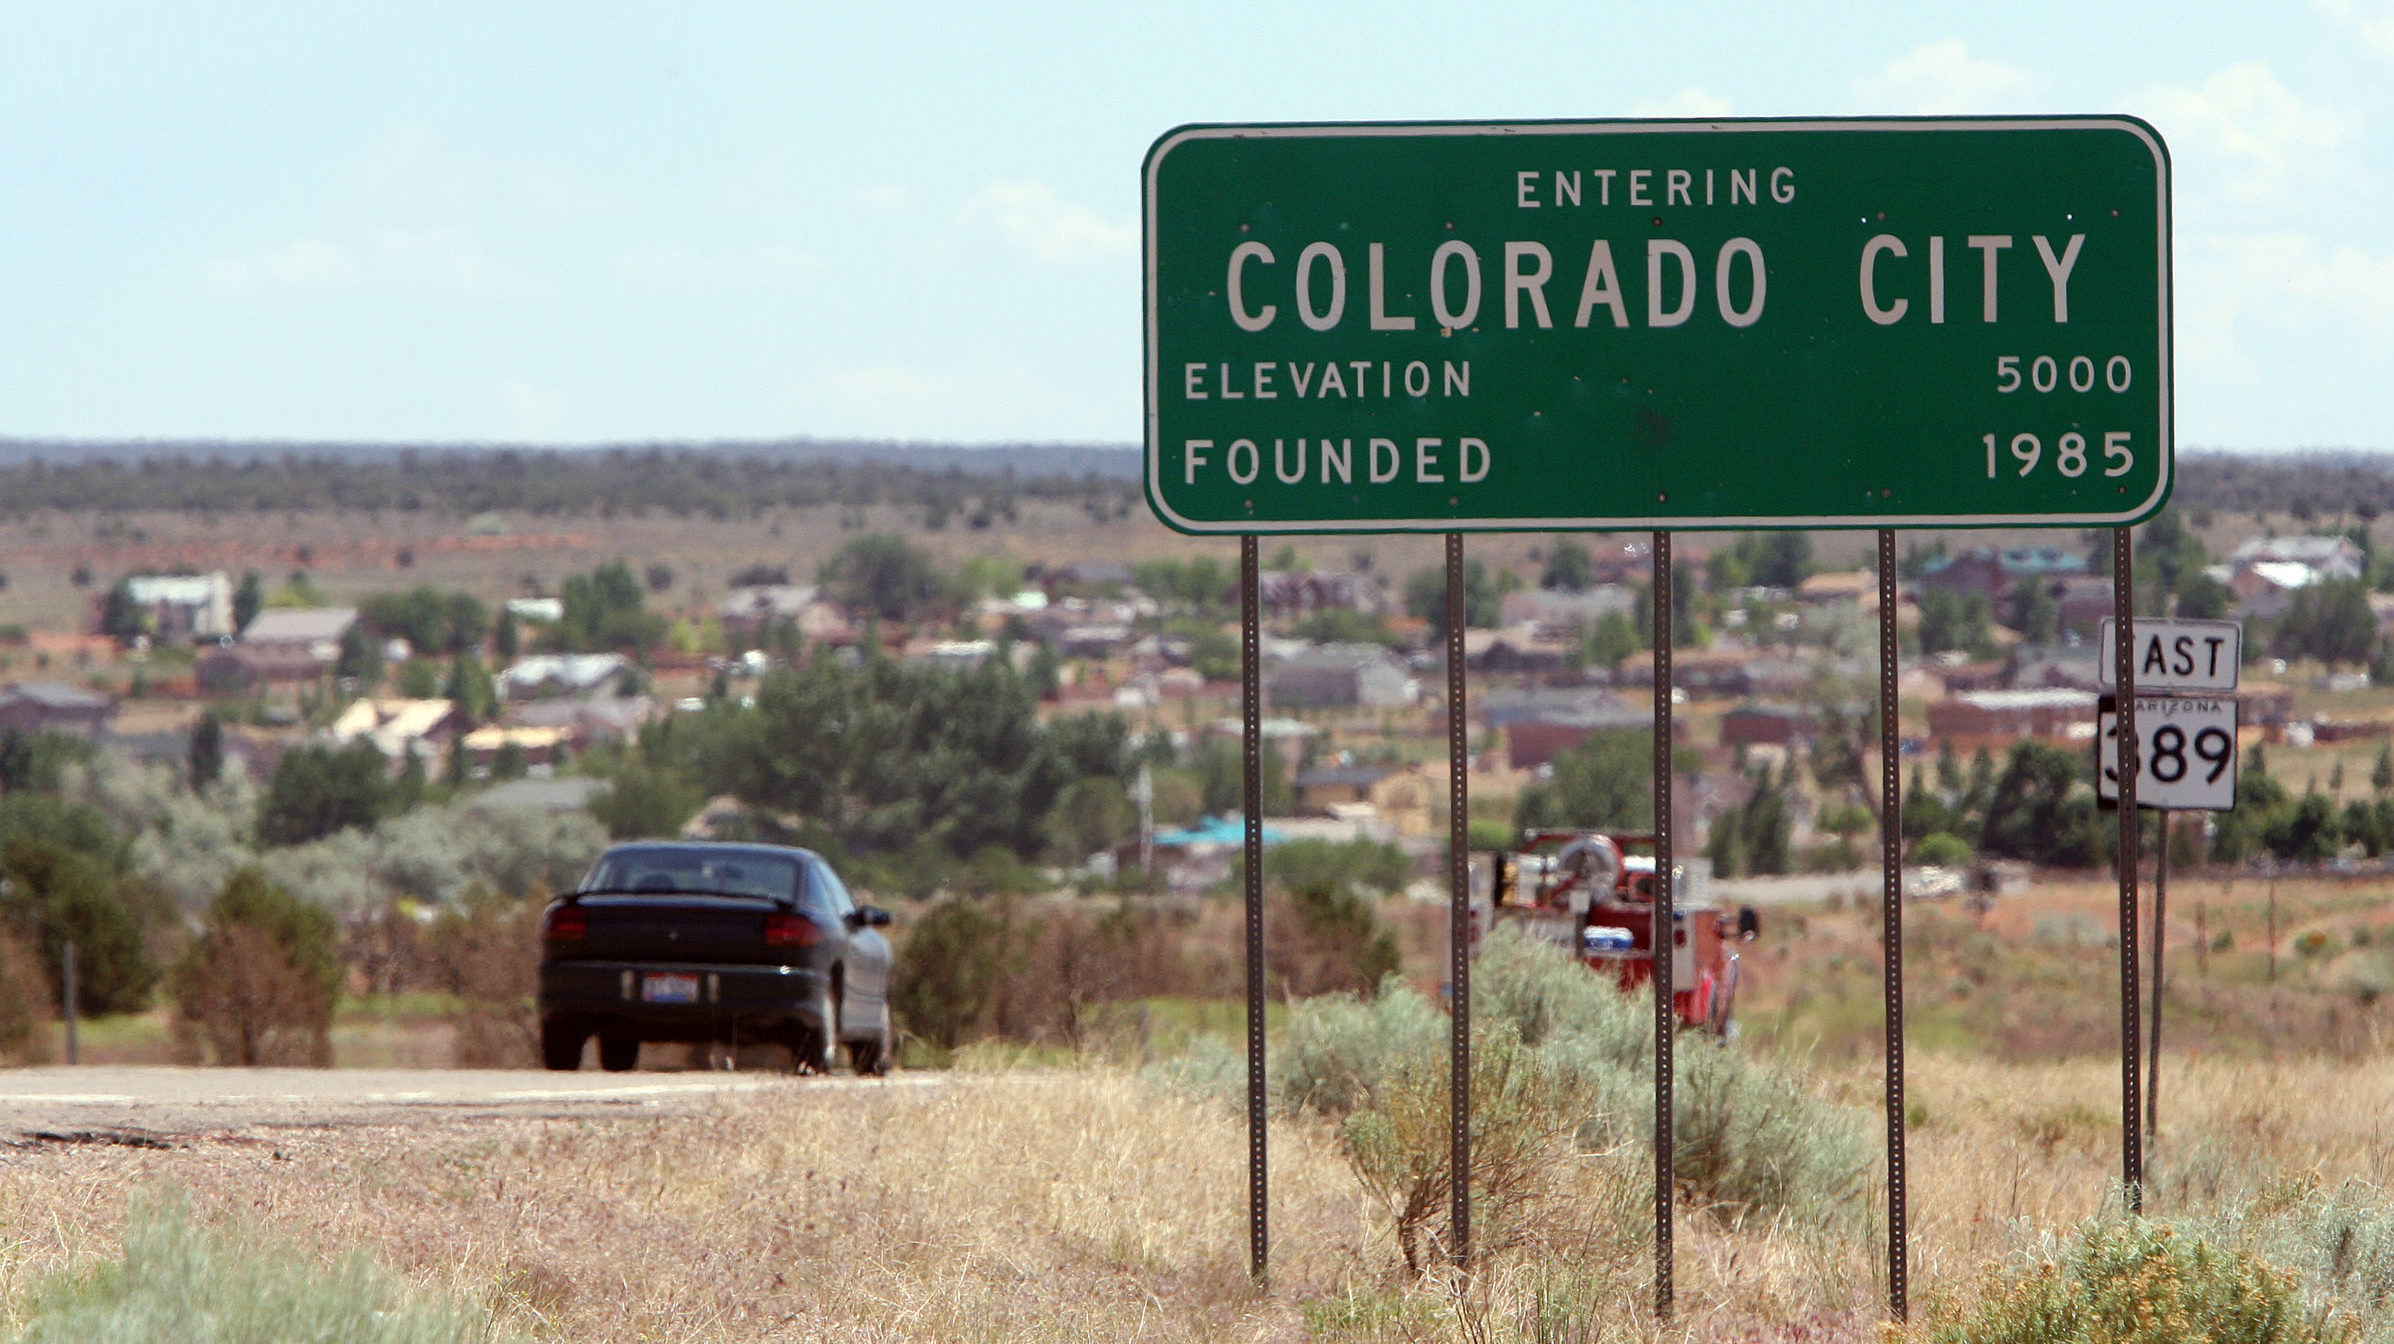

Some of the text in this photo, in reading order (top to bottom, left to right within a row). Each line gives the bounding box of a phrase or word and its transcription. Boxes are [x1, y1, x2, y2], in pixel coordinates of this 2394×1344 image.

[1517, 168, 1796, 208] ENTERING
[1227, 235, 2086, 332] COLORADO CITY
[1184, 356, 2132, 399] ELEVATION 5000
[1184, 433, 2135, 485] FOUNDED 1985
[2115, 634, 2224, 676] AST
[2135, 701, 2221, 712] ARIZONA
